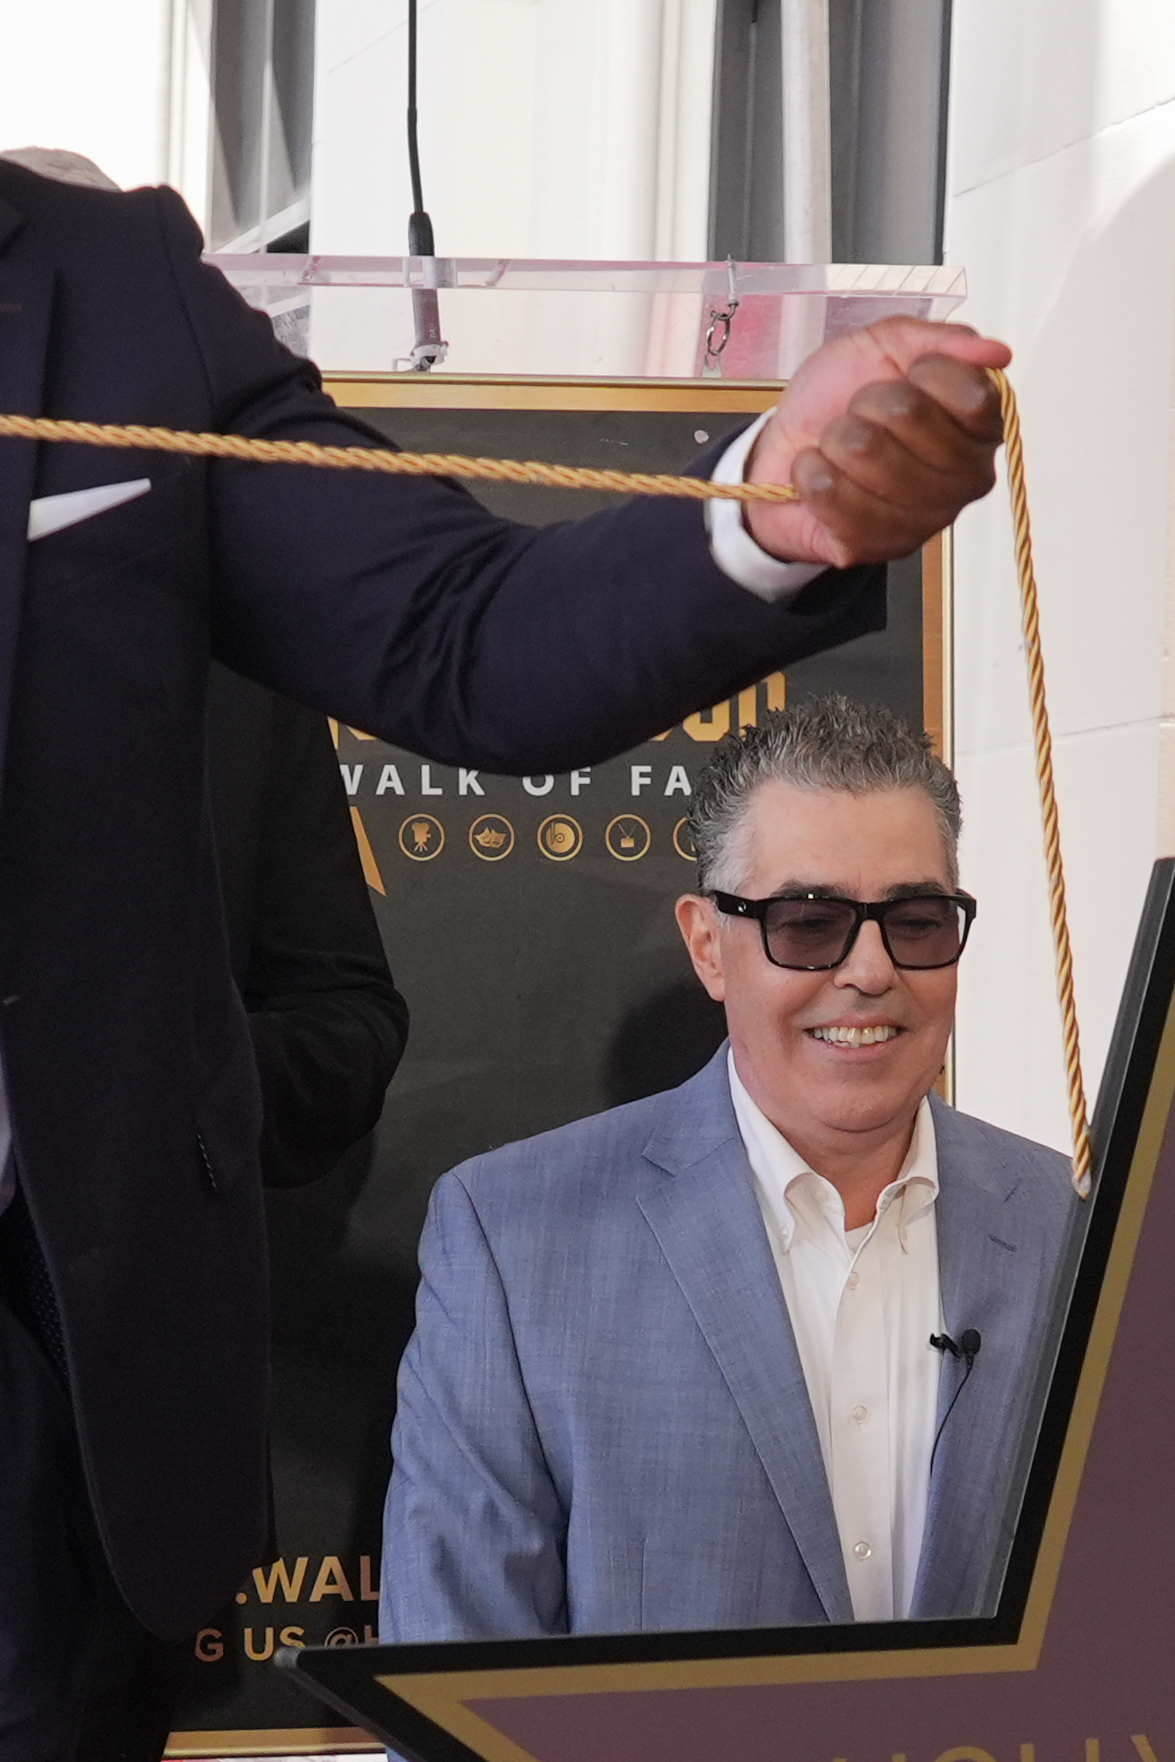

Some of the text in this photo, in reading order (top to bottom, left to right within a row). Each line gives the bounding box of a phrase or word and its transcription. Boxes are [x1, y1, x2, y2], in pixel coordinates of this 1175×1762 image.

[340, 764, 485, 797] WALK
[630, 764, 693, 797] FA
[234, 1554, 381, 1605] .WAL
